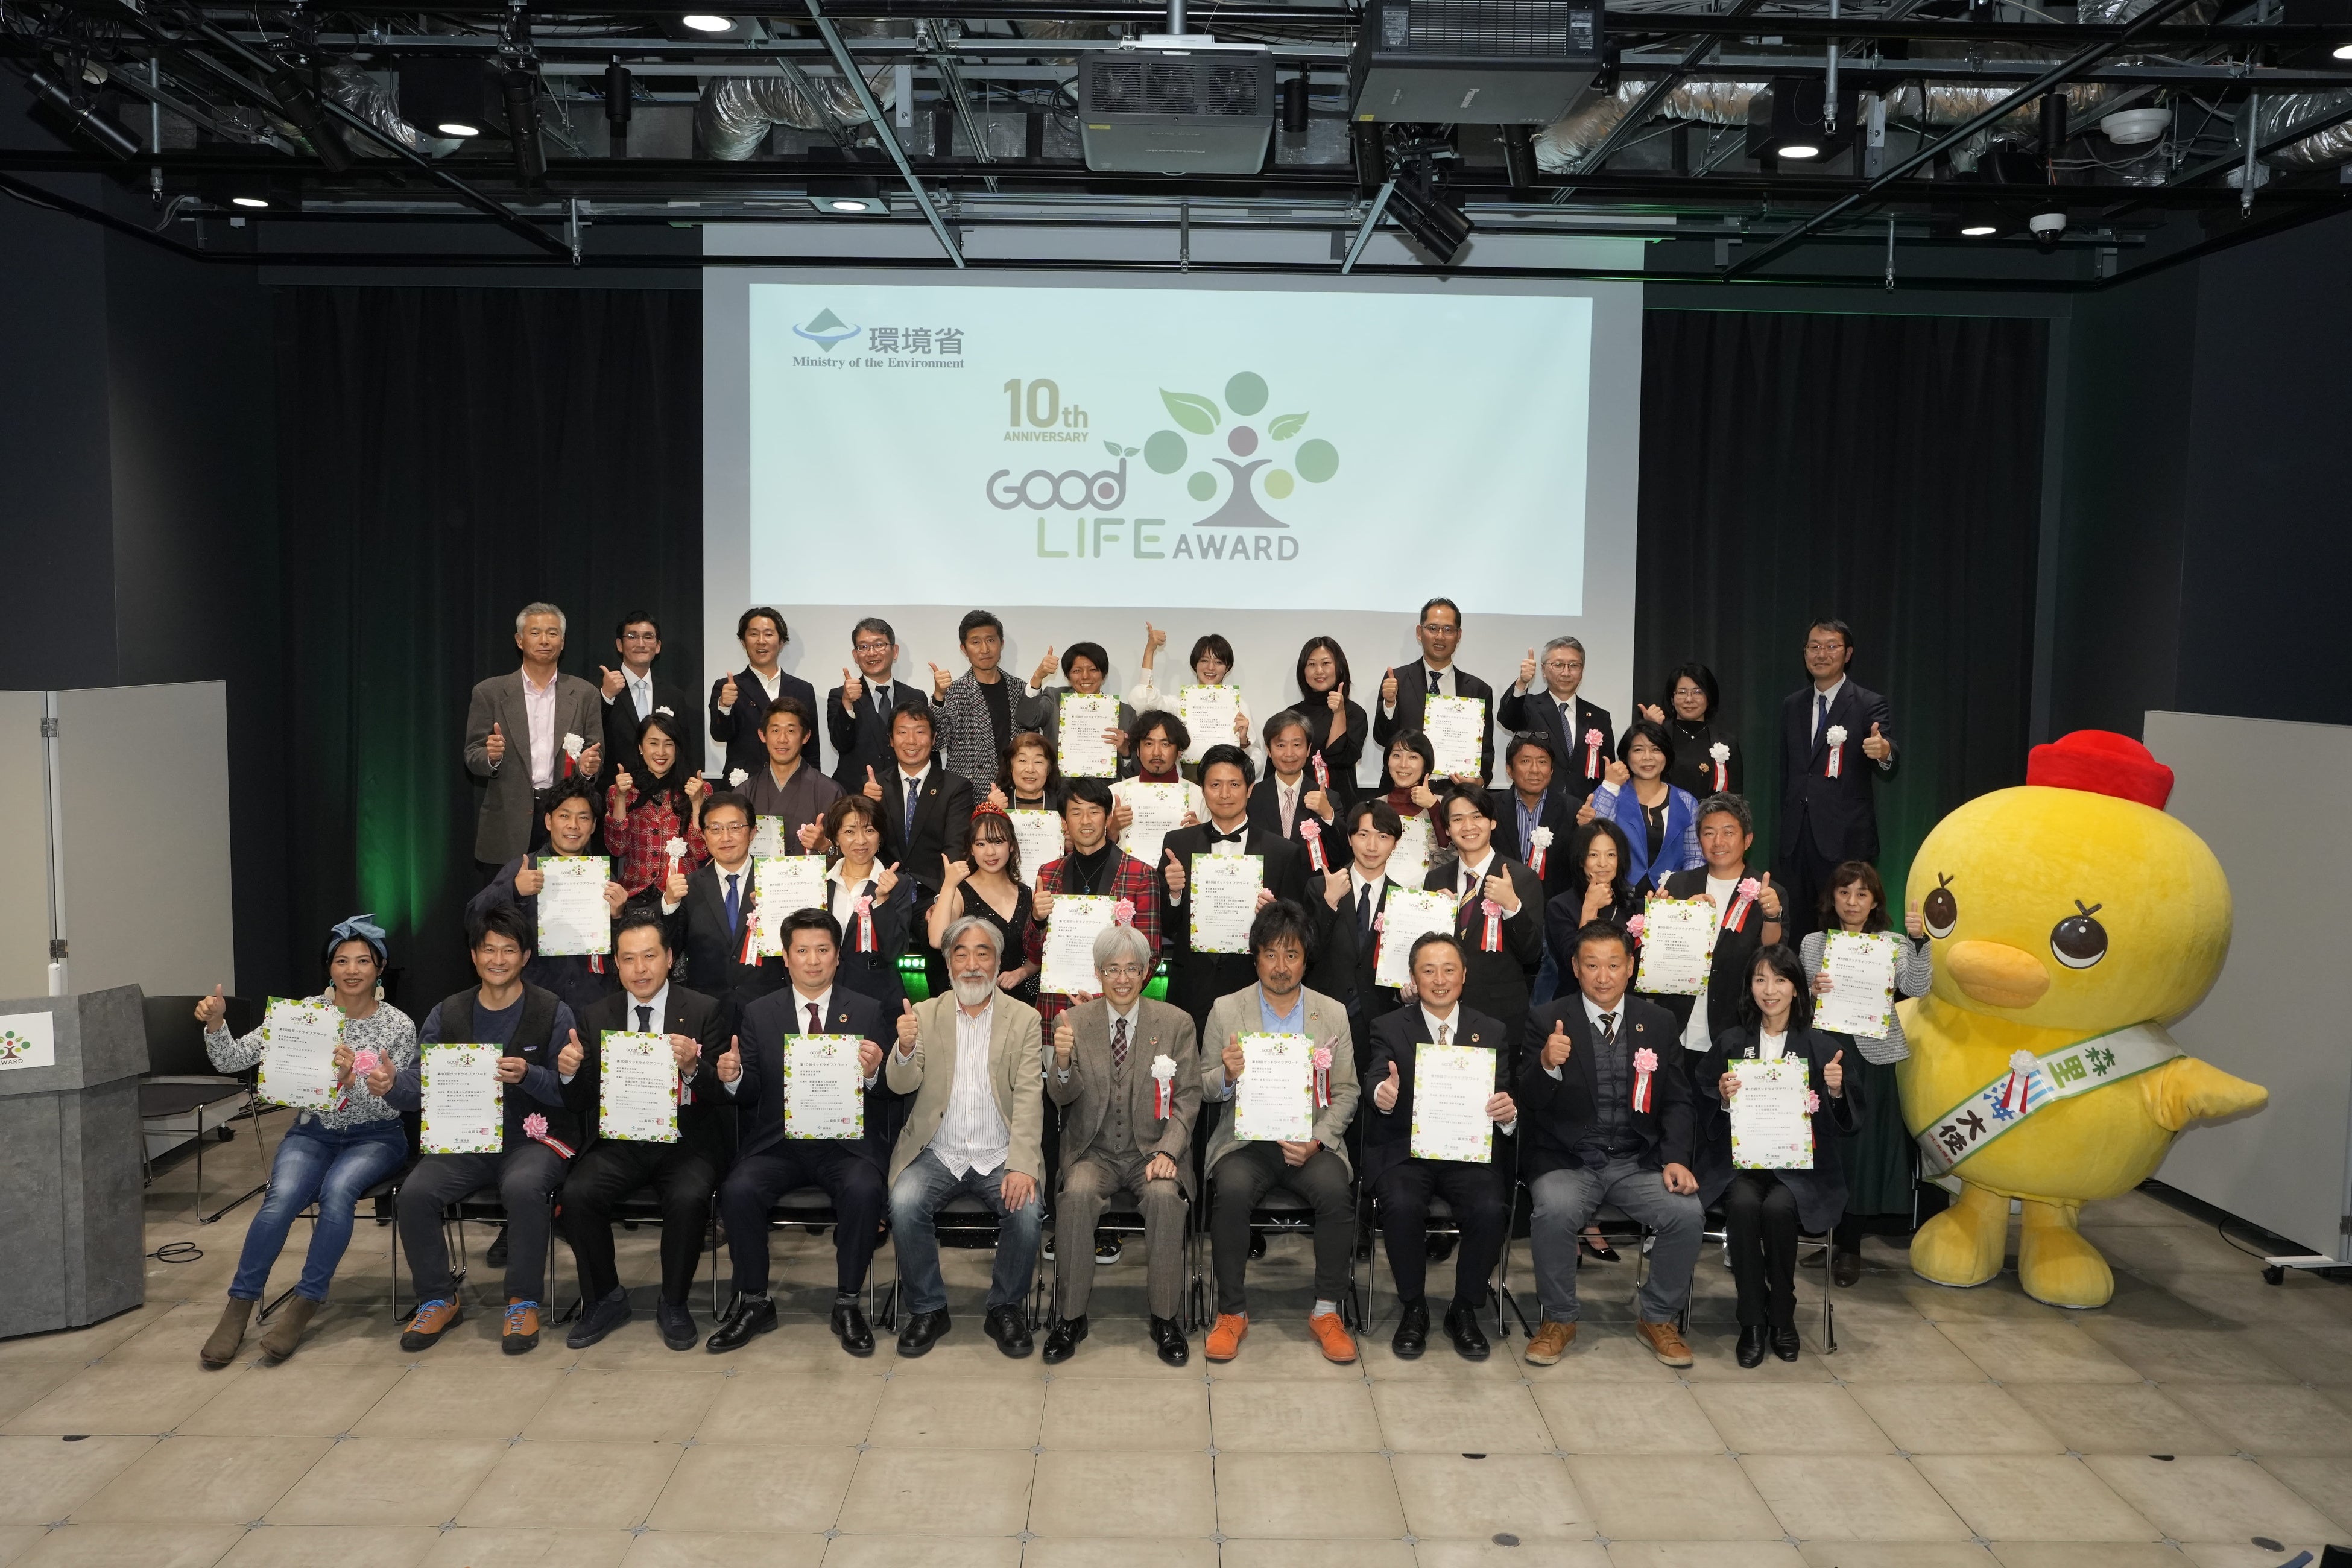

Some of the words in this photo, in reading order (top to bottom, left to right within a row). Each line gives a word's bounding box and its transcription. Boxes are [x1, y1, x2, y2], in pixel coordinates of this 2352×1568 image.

[869, 327, 964, 355] 環境省
[793, 357, 845, 369] Ministry
[849, 358, 861, 367] of
[865, 358, 884, 367] the
[888, 358, 965, 368] Environment
[1004, 378, 1089, 428] 10th
[1004, 431, 1089, 442] ANNIVERSARY
[1037, 517, 1166, 559] LIFE
[1172, 534, 1299, 561] AWARD
